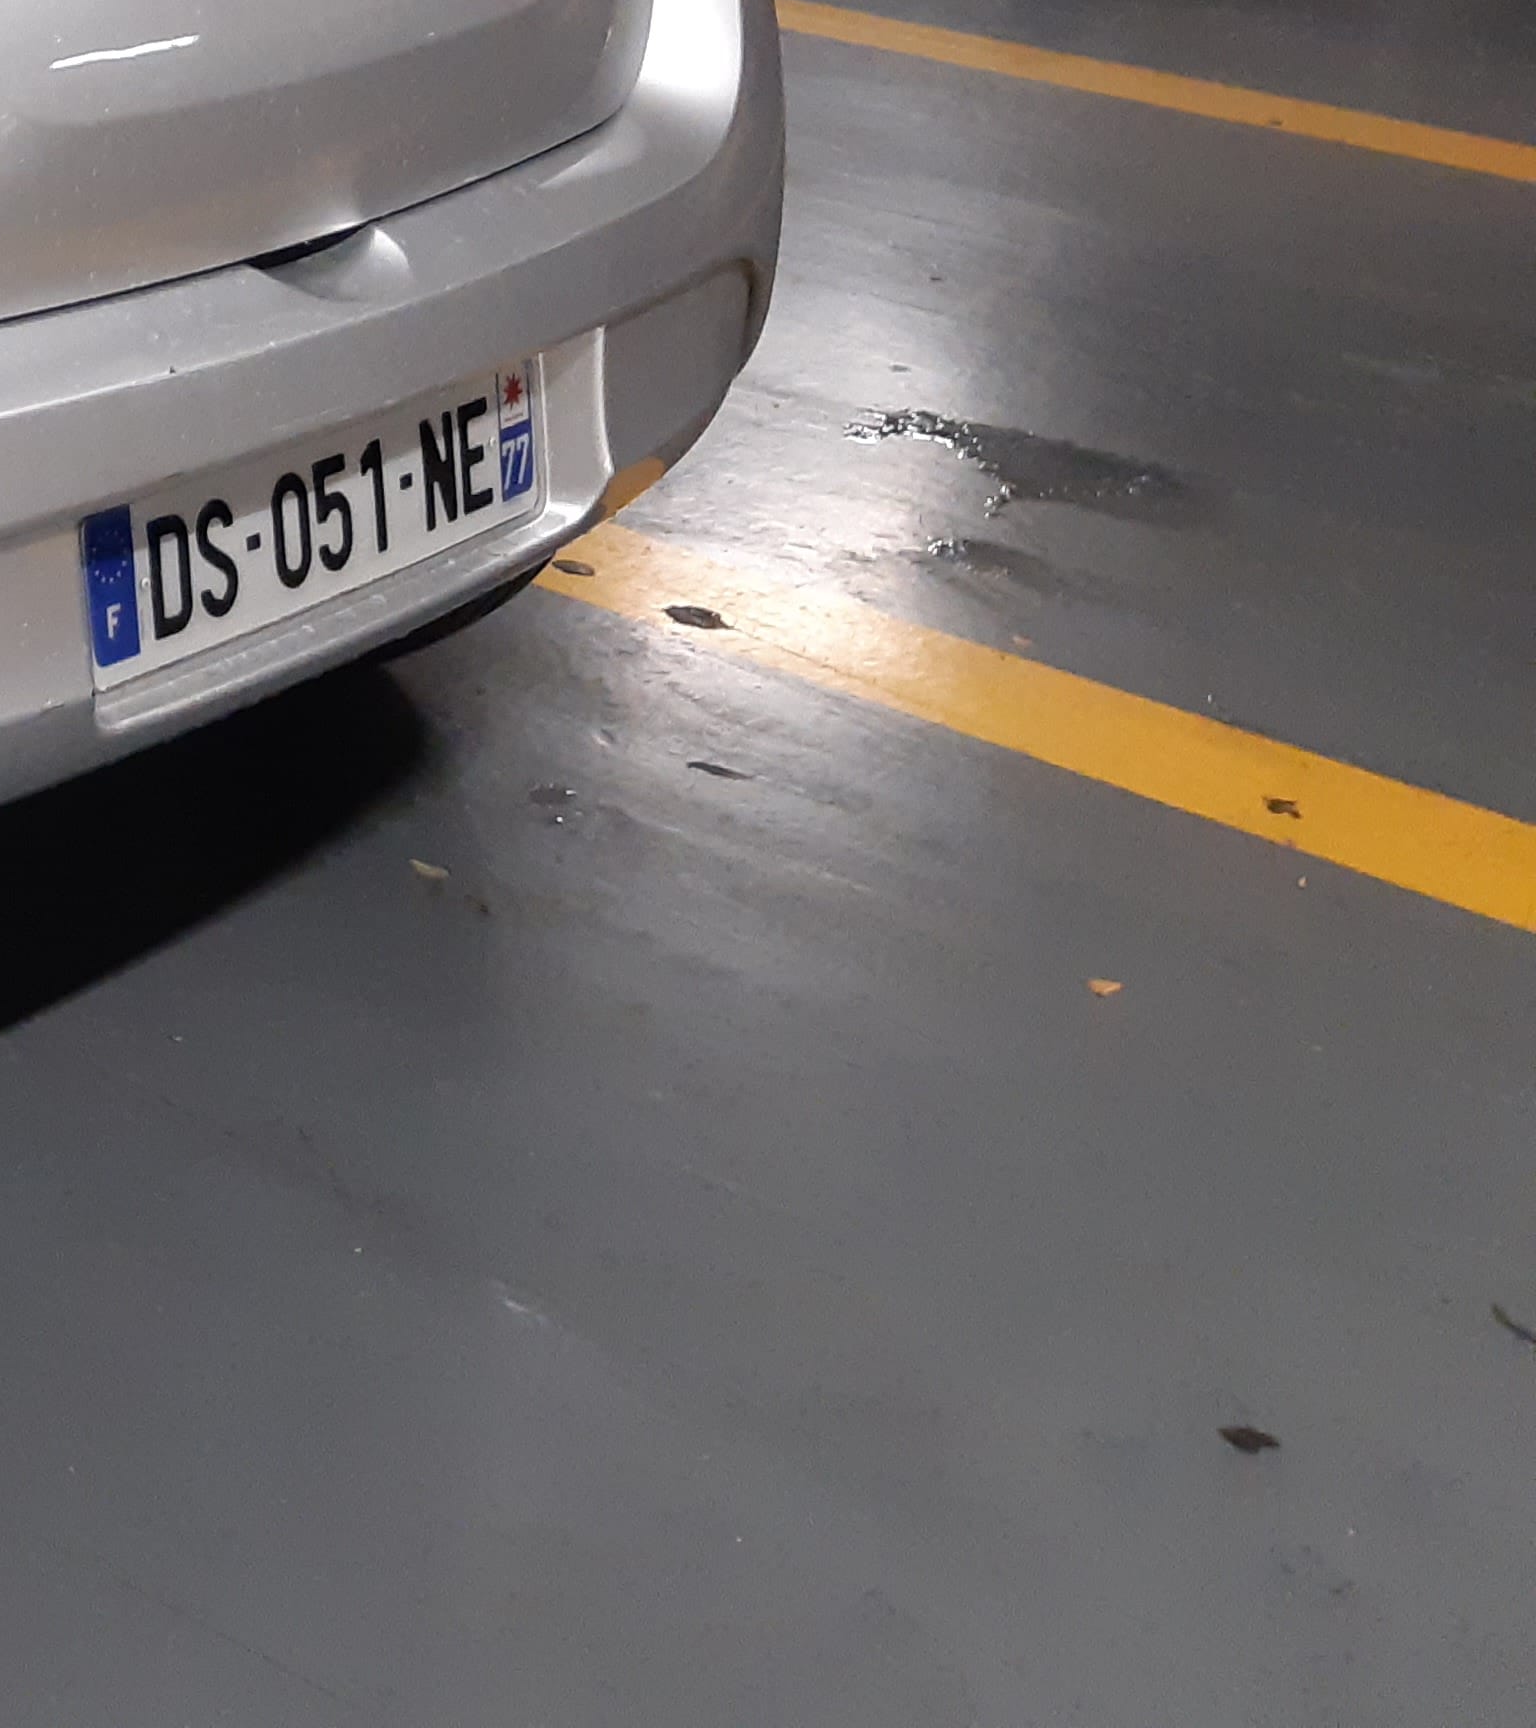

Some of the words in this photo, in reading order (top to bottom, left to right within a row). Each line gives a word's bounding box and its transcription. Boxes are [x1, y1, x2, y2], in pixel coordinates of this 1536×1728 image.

[501, 432, 530, 491] 77
[145, 396, 495, 641] DS-051-NE
[105, 602, 122, 641] F
